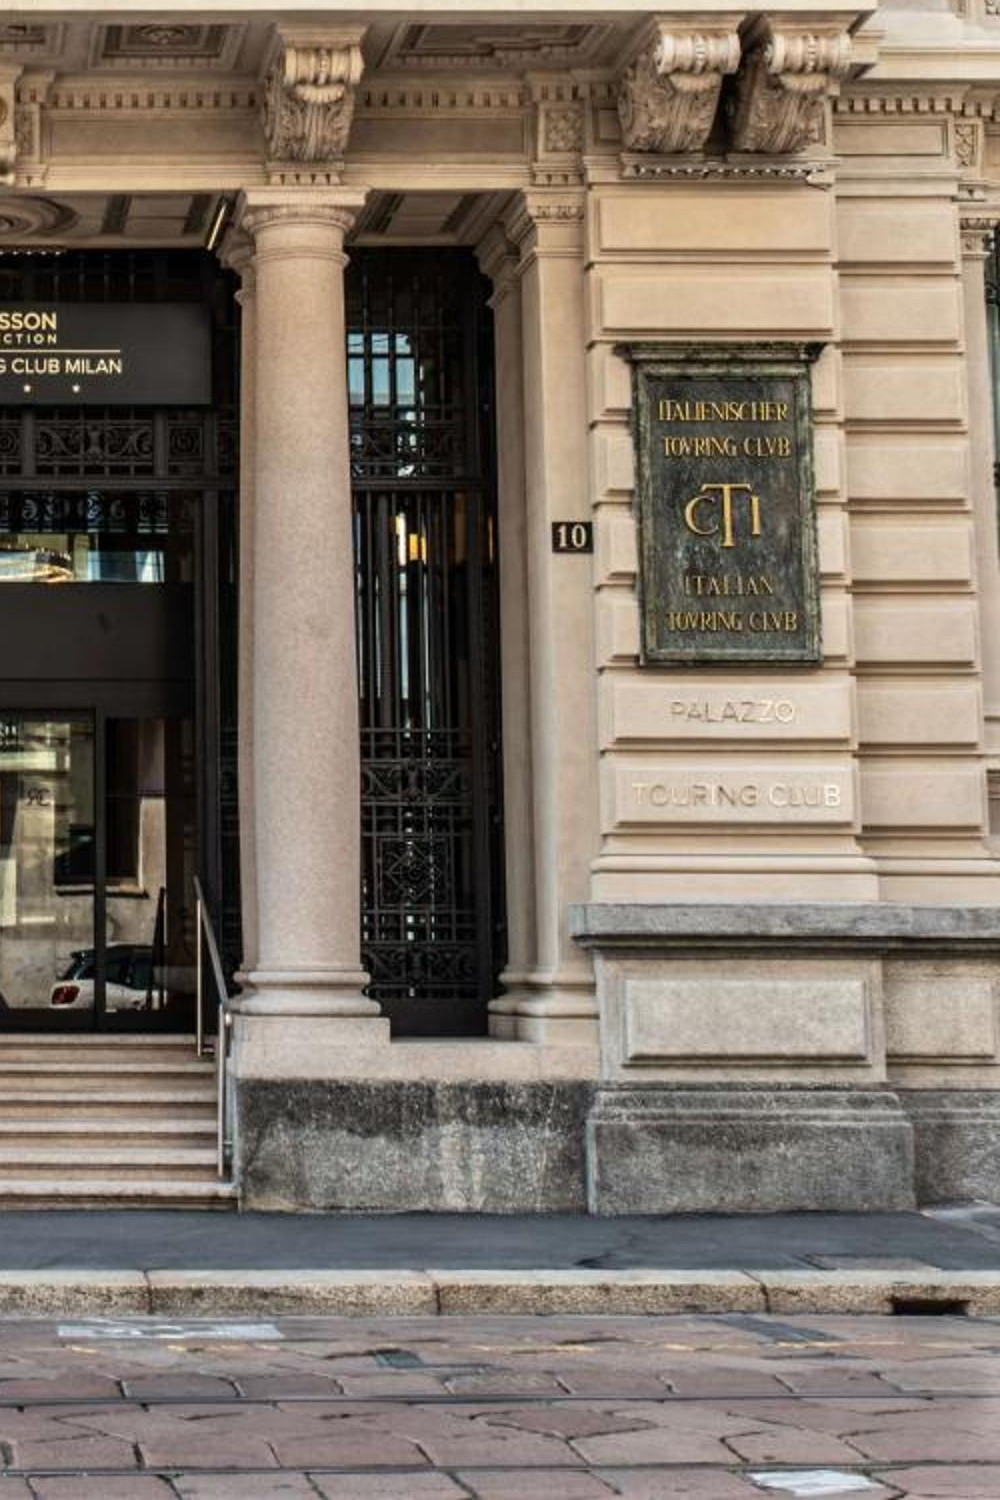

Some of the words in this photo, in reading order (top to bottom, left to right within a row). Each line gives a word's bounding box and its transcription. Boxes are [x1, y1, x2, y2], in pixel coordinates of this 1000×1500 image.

[11, 357, 61, 375] CLUB
[65, 357, 123, 375] MILAN
[659, 400, 788, 421] ITALIENISCHER
[556, 524, 588, 550] 10
[684, 575, 774, 596] ITALIAN
[669, 700, 795, 723] PALAZZO
[631, 782, 760, 808] TOURING
[768, 782, 842, 809] CLUB
